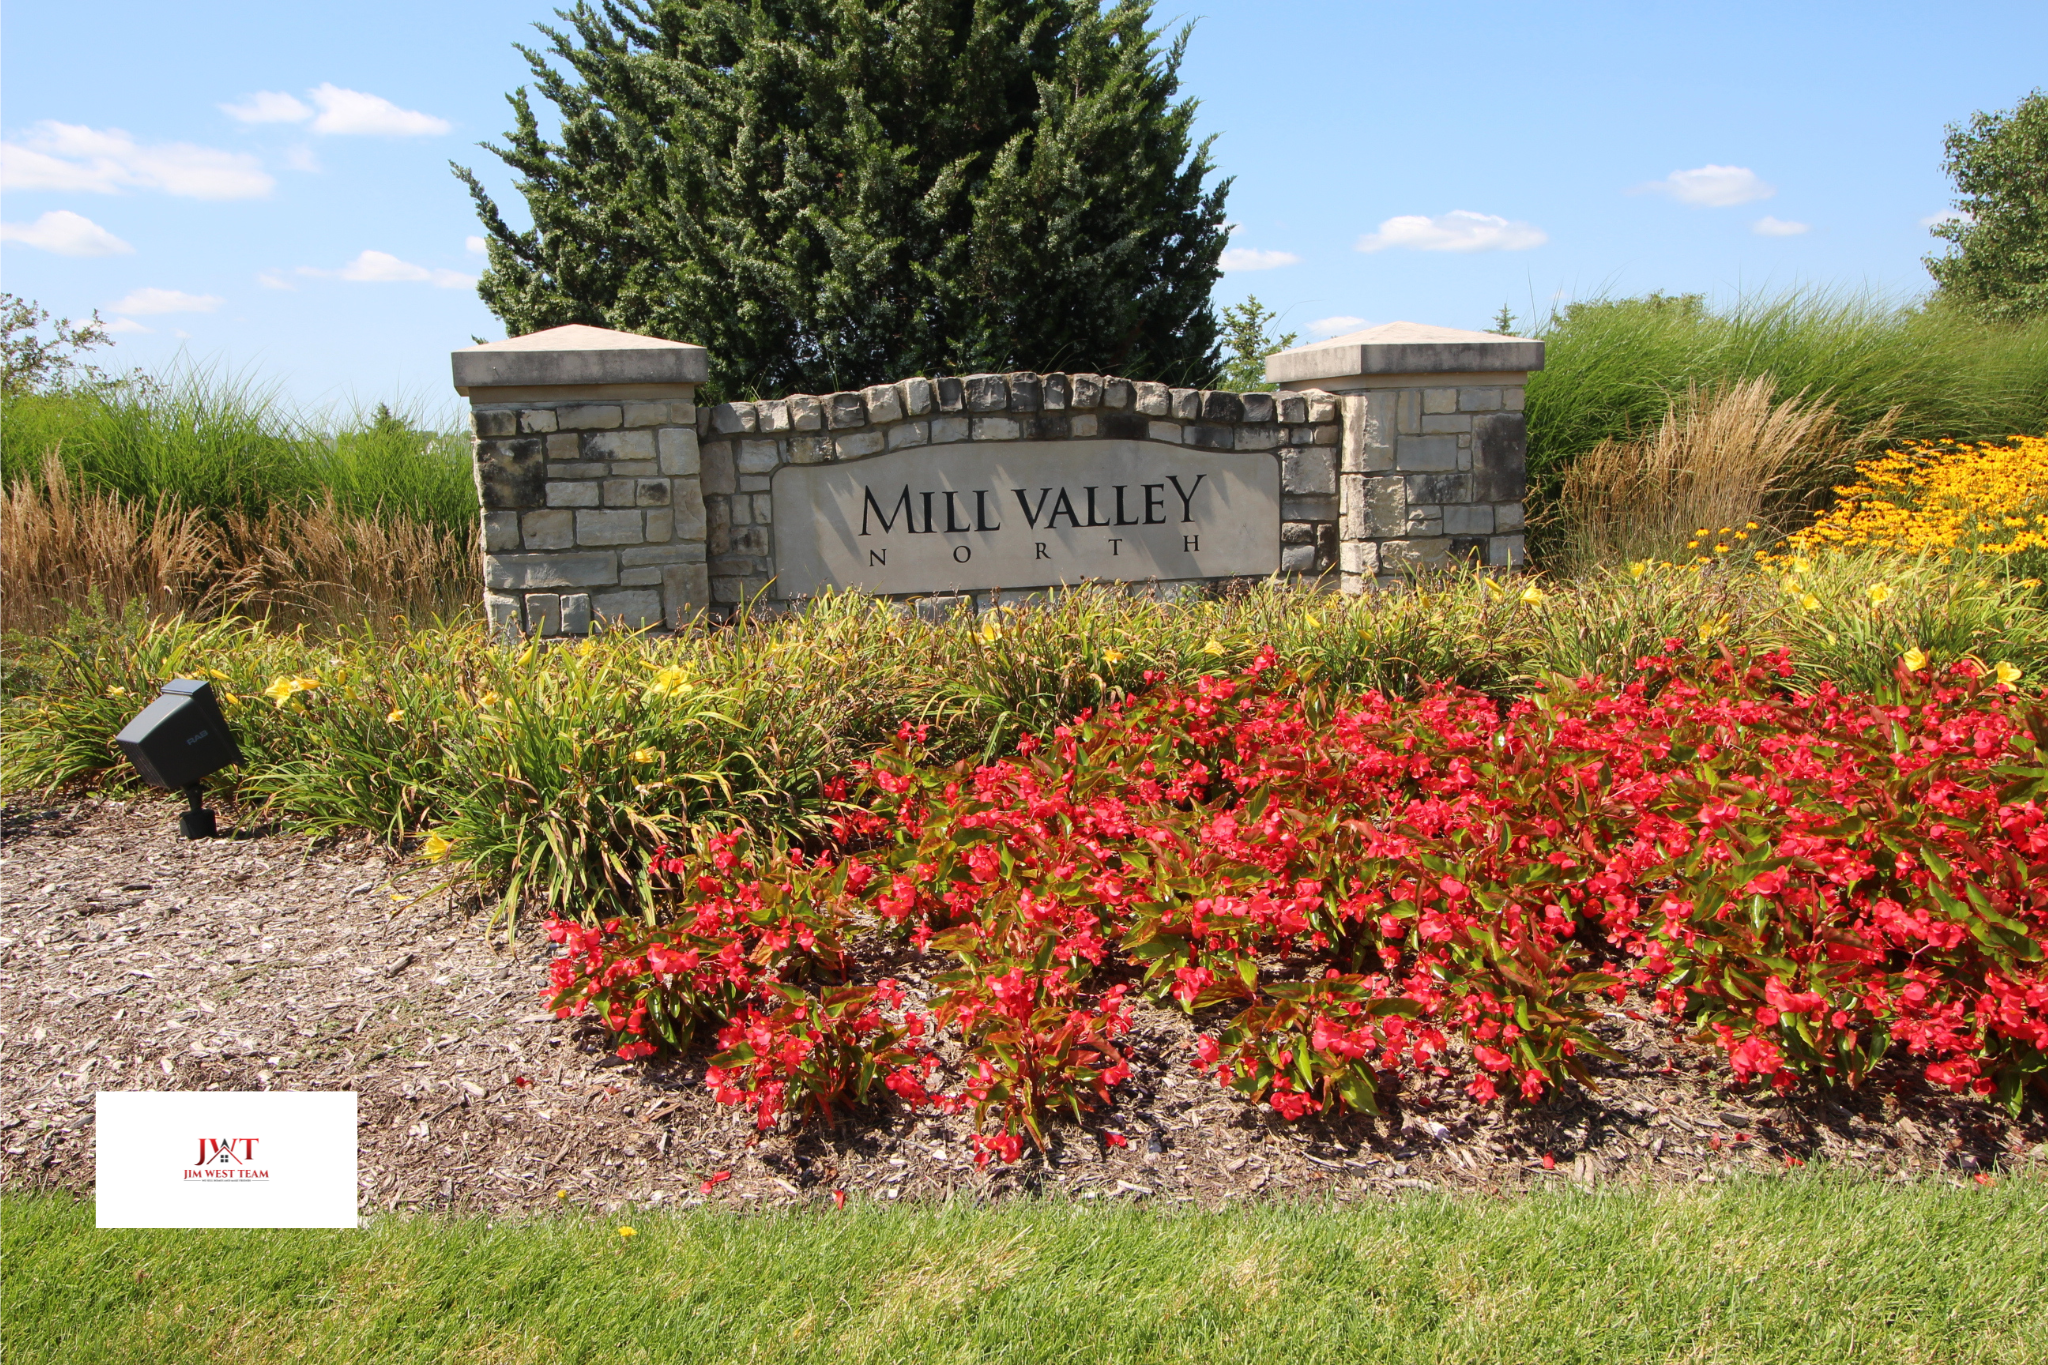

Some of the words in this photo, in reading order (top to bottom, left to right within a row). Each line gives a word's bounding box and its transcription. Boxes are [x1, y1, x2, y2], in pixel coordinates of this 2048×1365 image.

[858, 483, 1001, 536] MILL
[1011, 474, 1207, 530] VALLEY
[869, 534, 1200, 567] NORTH
[187, 730, 208, 745] RAB
